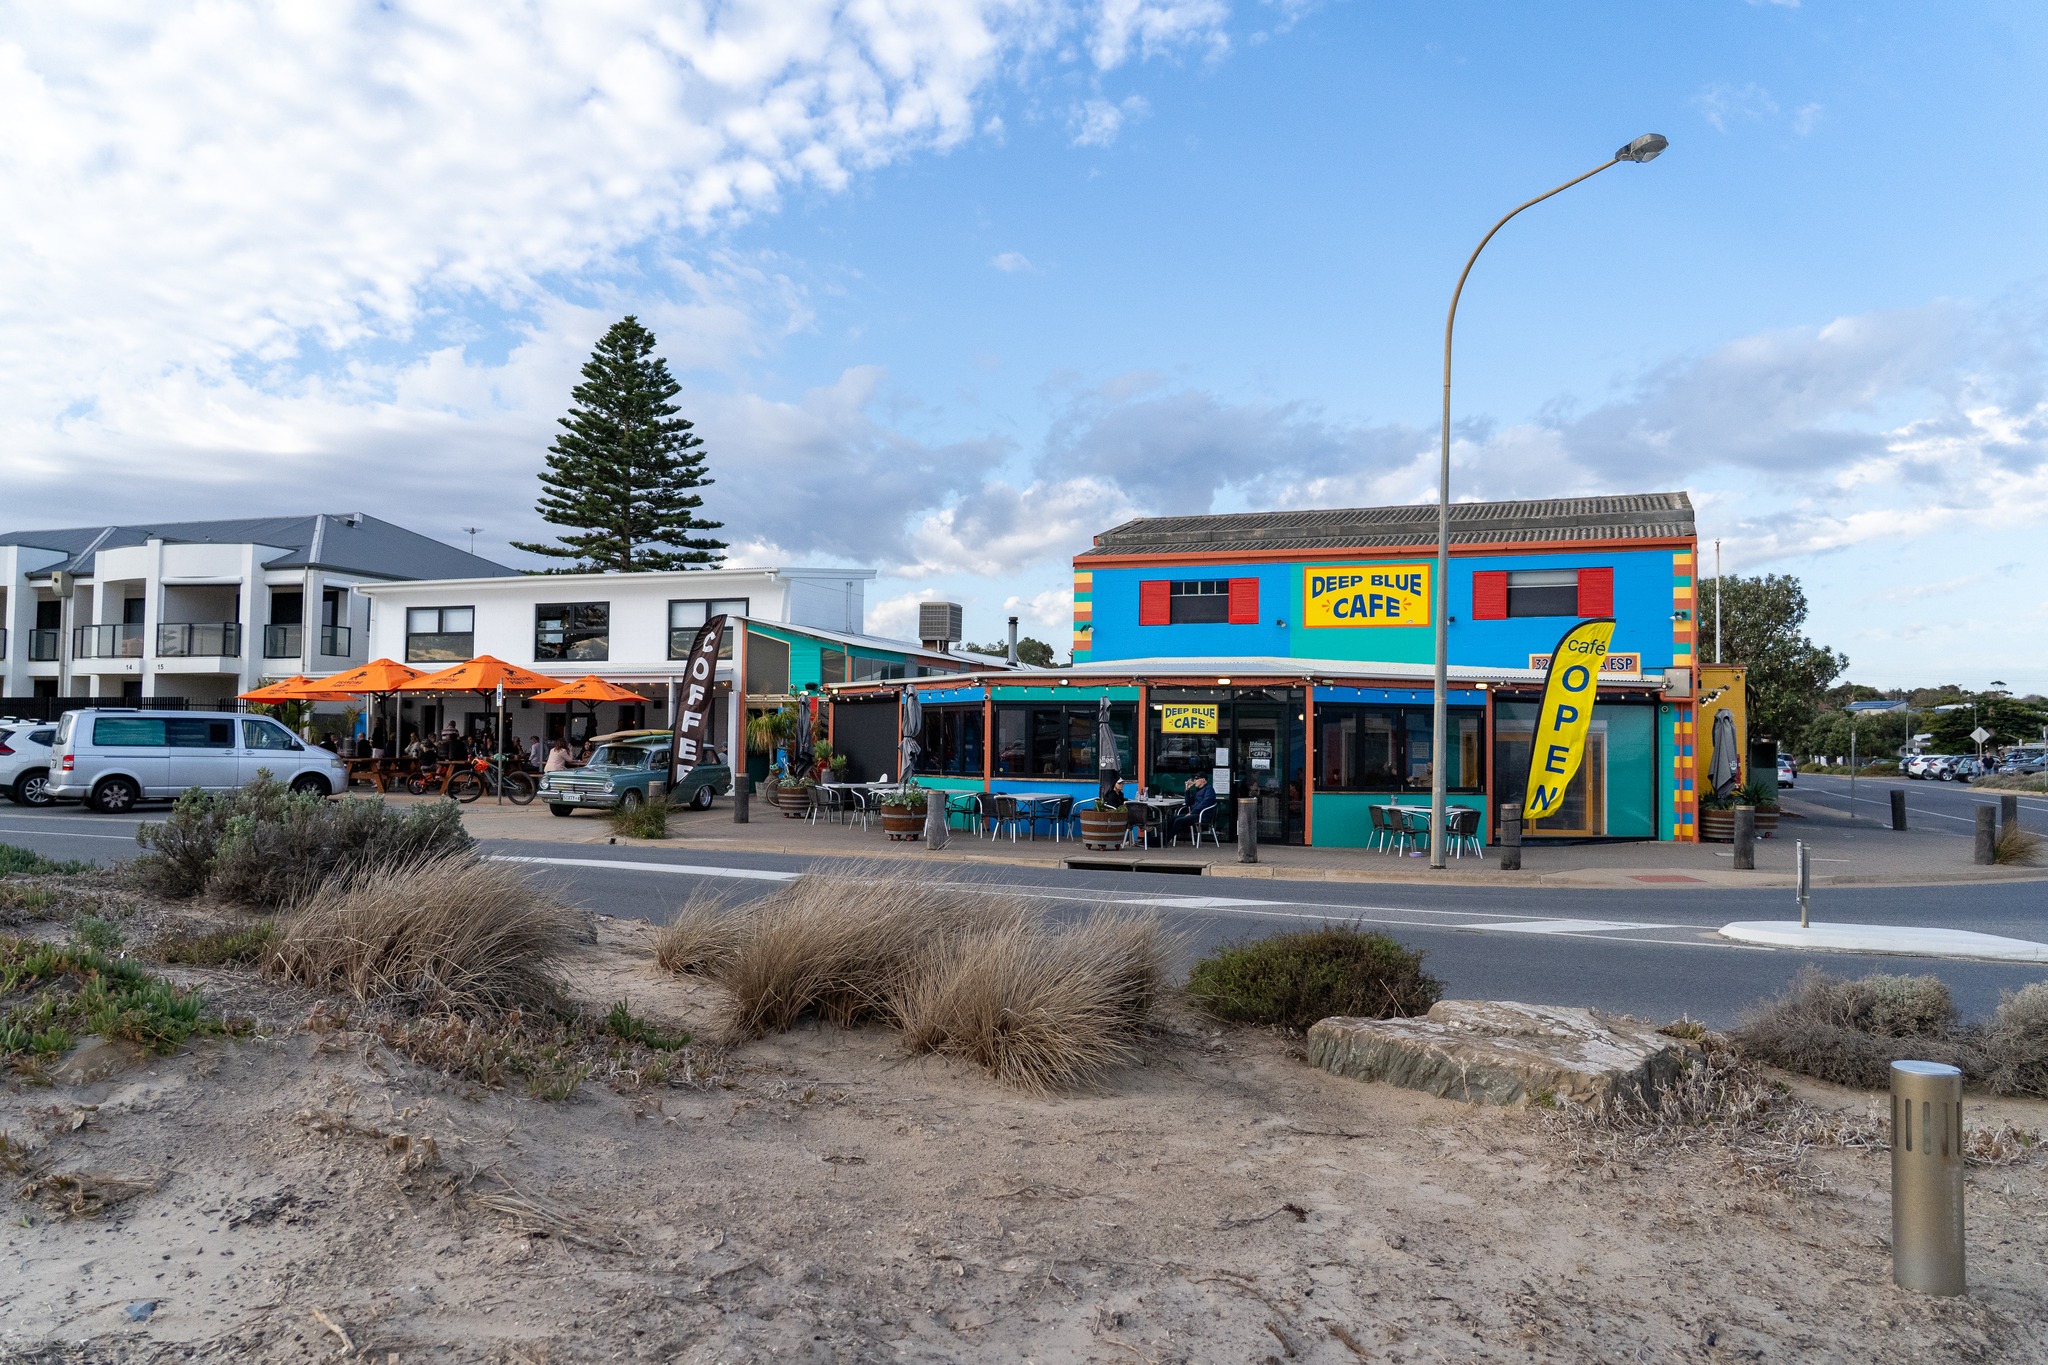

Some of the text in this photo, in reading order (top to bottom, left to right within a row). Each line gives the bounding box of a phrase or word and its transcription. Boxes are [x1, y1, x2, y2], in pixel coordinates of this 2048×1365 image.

[1311, 573, 1422, 599] DEEP BLUE
[1332, 593, 1400, 619] CAFE
[1567, 639, 1606, 656] café
[1610, 657, 1633, 670] ESP
[1165, 707, 1215, 719] DEEP BLUE
[1174, 716, 1206, 729] CAFE
[1529, 664, 1591, 811] OPEN
